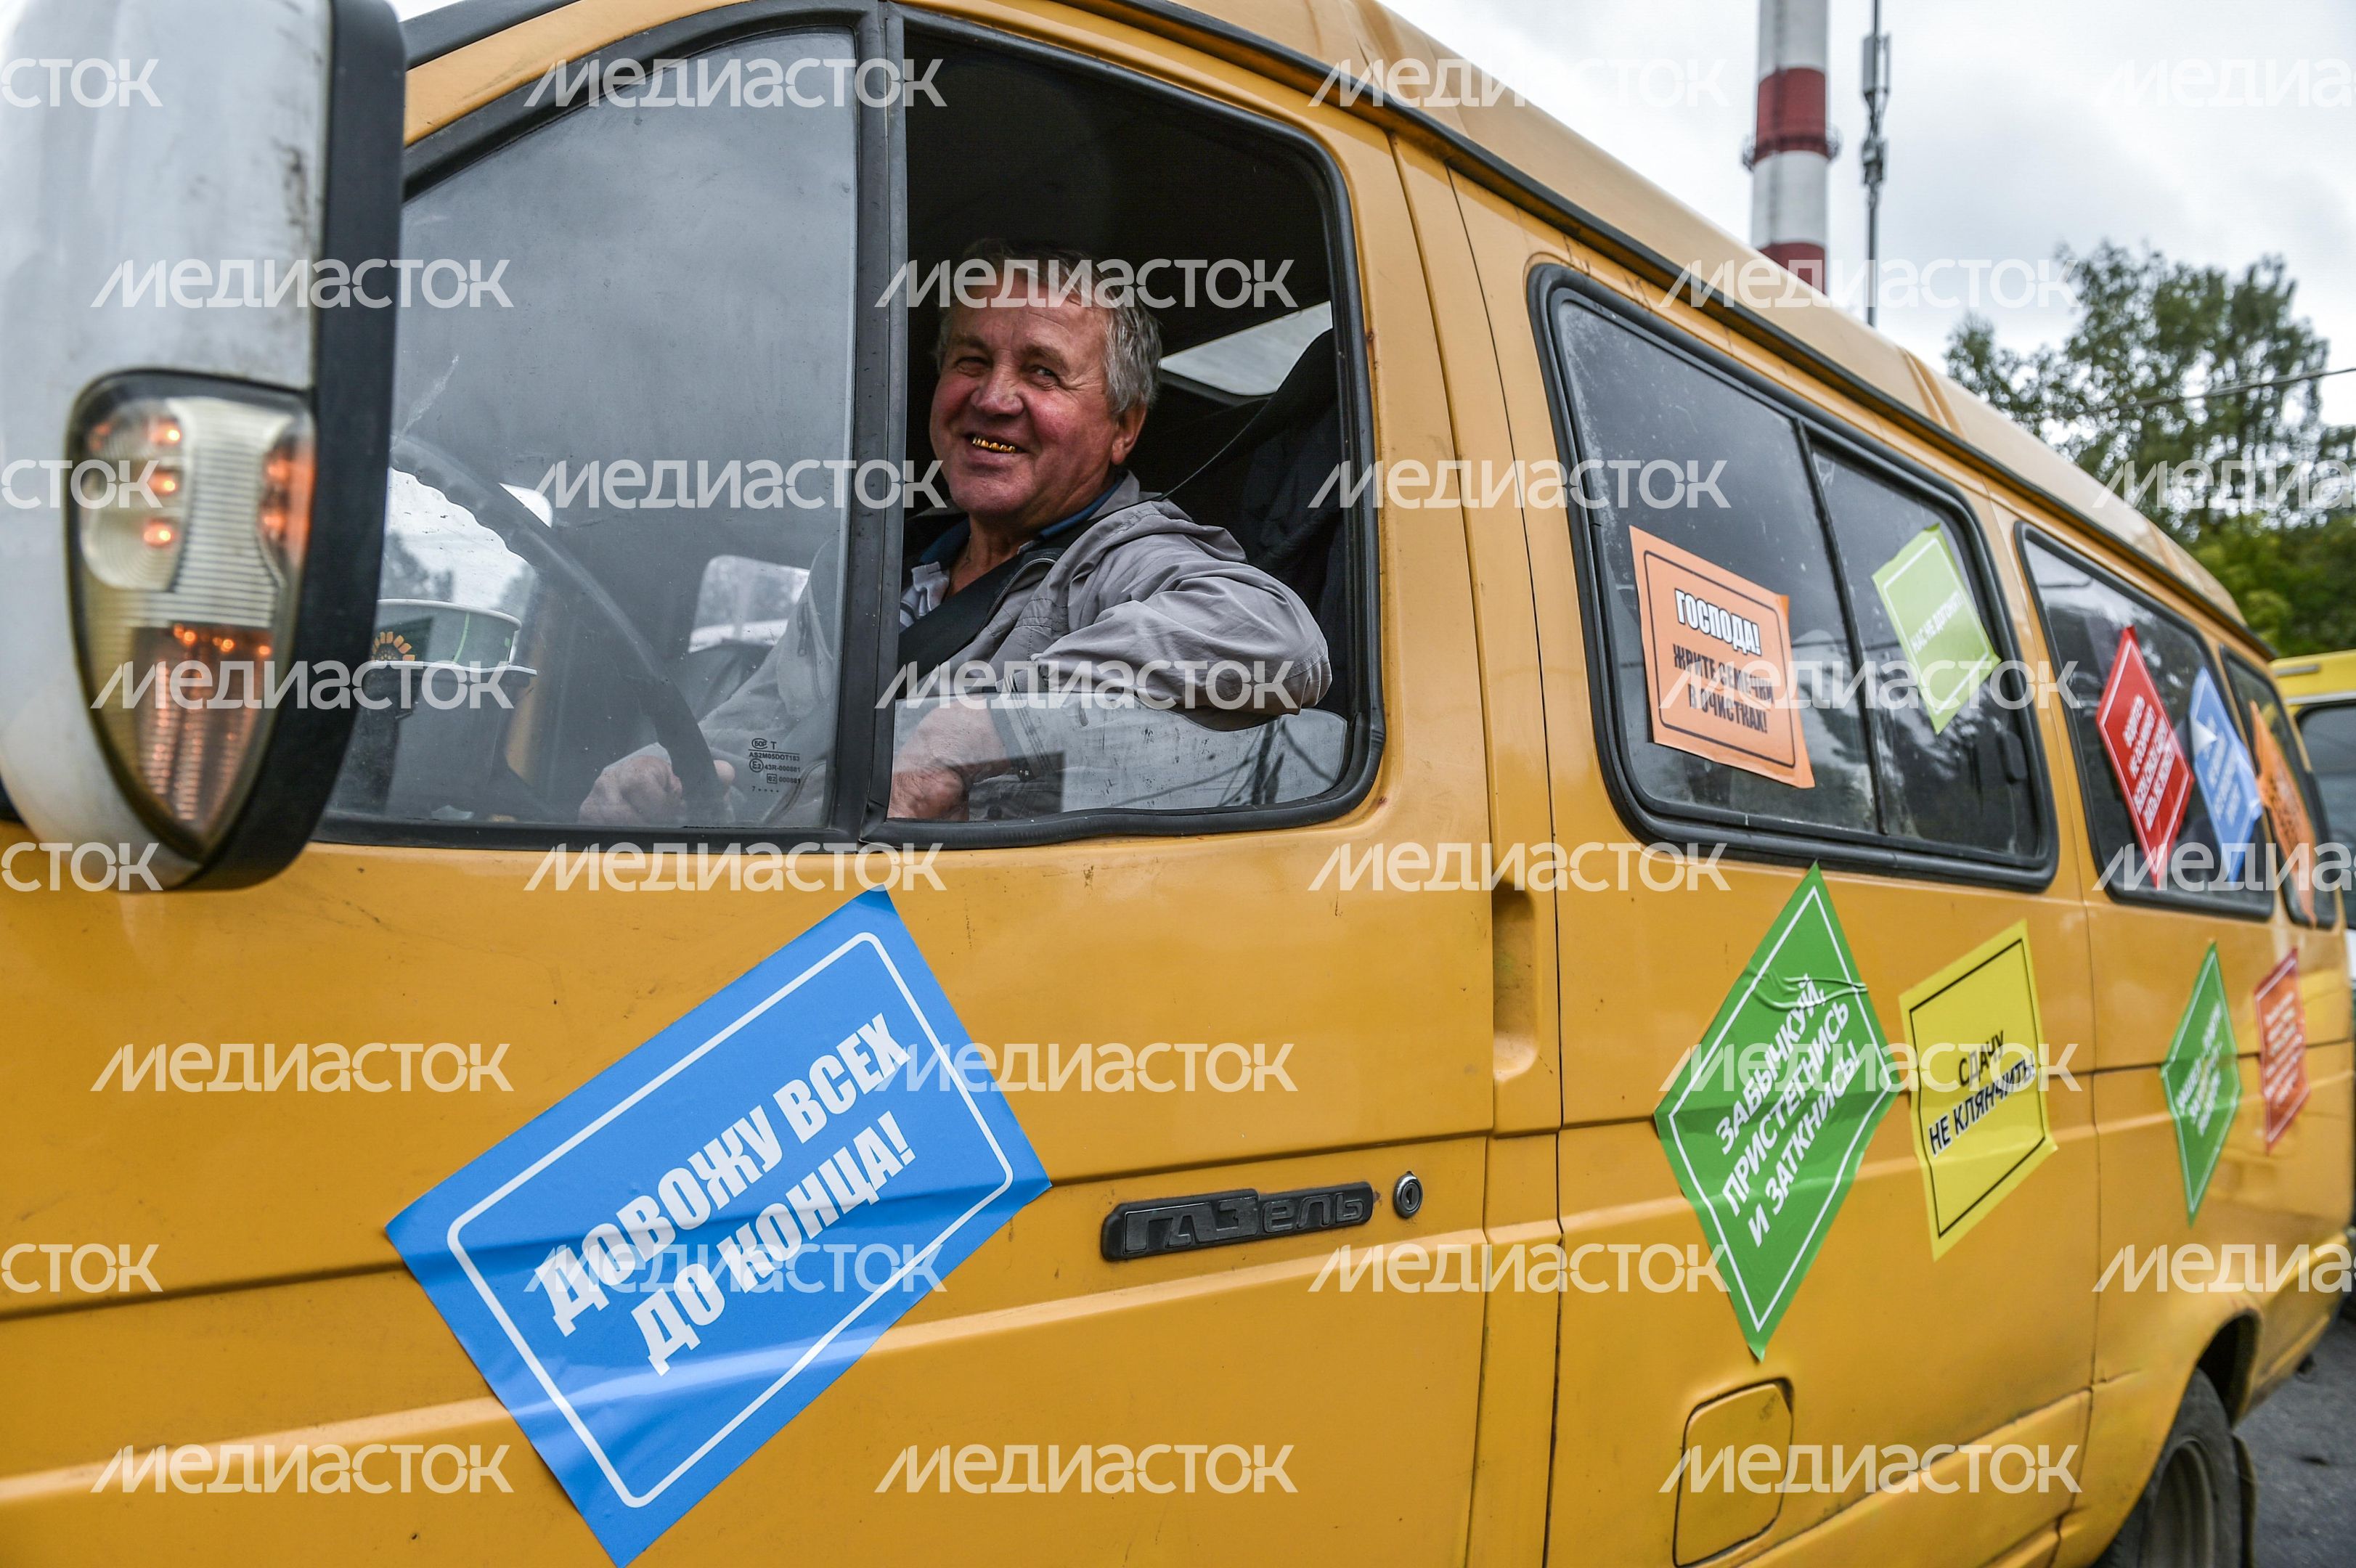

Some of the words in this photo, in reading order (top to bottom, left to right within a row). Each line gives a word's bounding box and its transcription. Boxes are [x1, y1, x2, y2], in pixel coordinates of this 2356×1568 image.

[1673, 644, 1717, 681] ЖРИТЕ
[1674, 588, 1762, 656] ГОСПОДА!
[1722, 1000, 1850, 1217] ПРИСТЕГНИСЬ
[1959, 1030, 2005, 1087] СДАЧУ
[535, 1109, 783, 1336] ДОВОЖУ
[773, 1013, 911, 1145] ВСЕХ
[1747, 1208, 1771, 1248] И
[1764, 1040, 1861, 1216] ЗАТКНИСЬ!
[1928, 1115, 1952, 1157] НЕ
[631, 1262, 726, 1376] ДО
[716, 1111, 916, 1293] КОНЦА!
